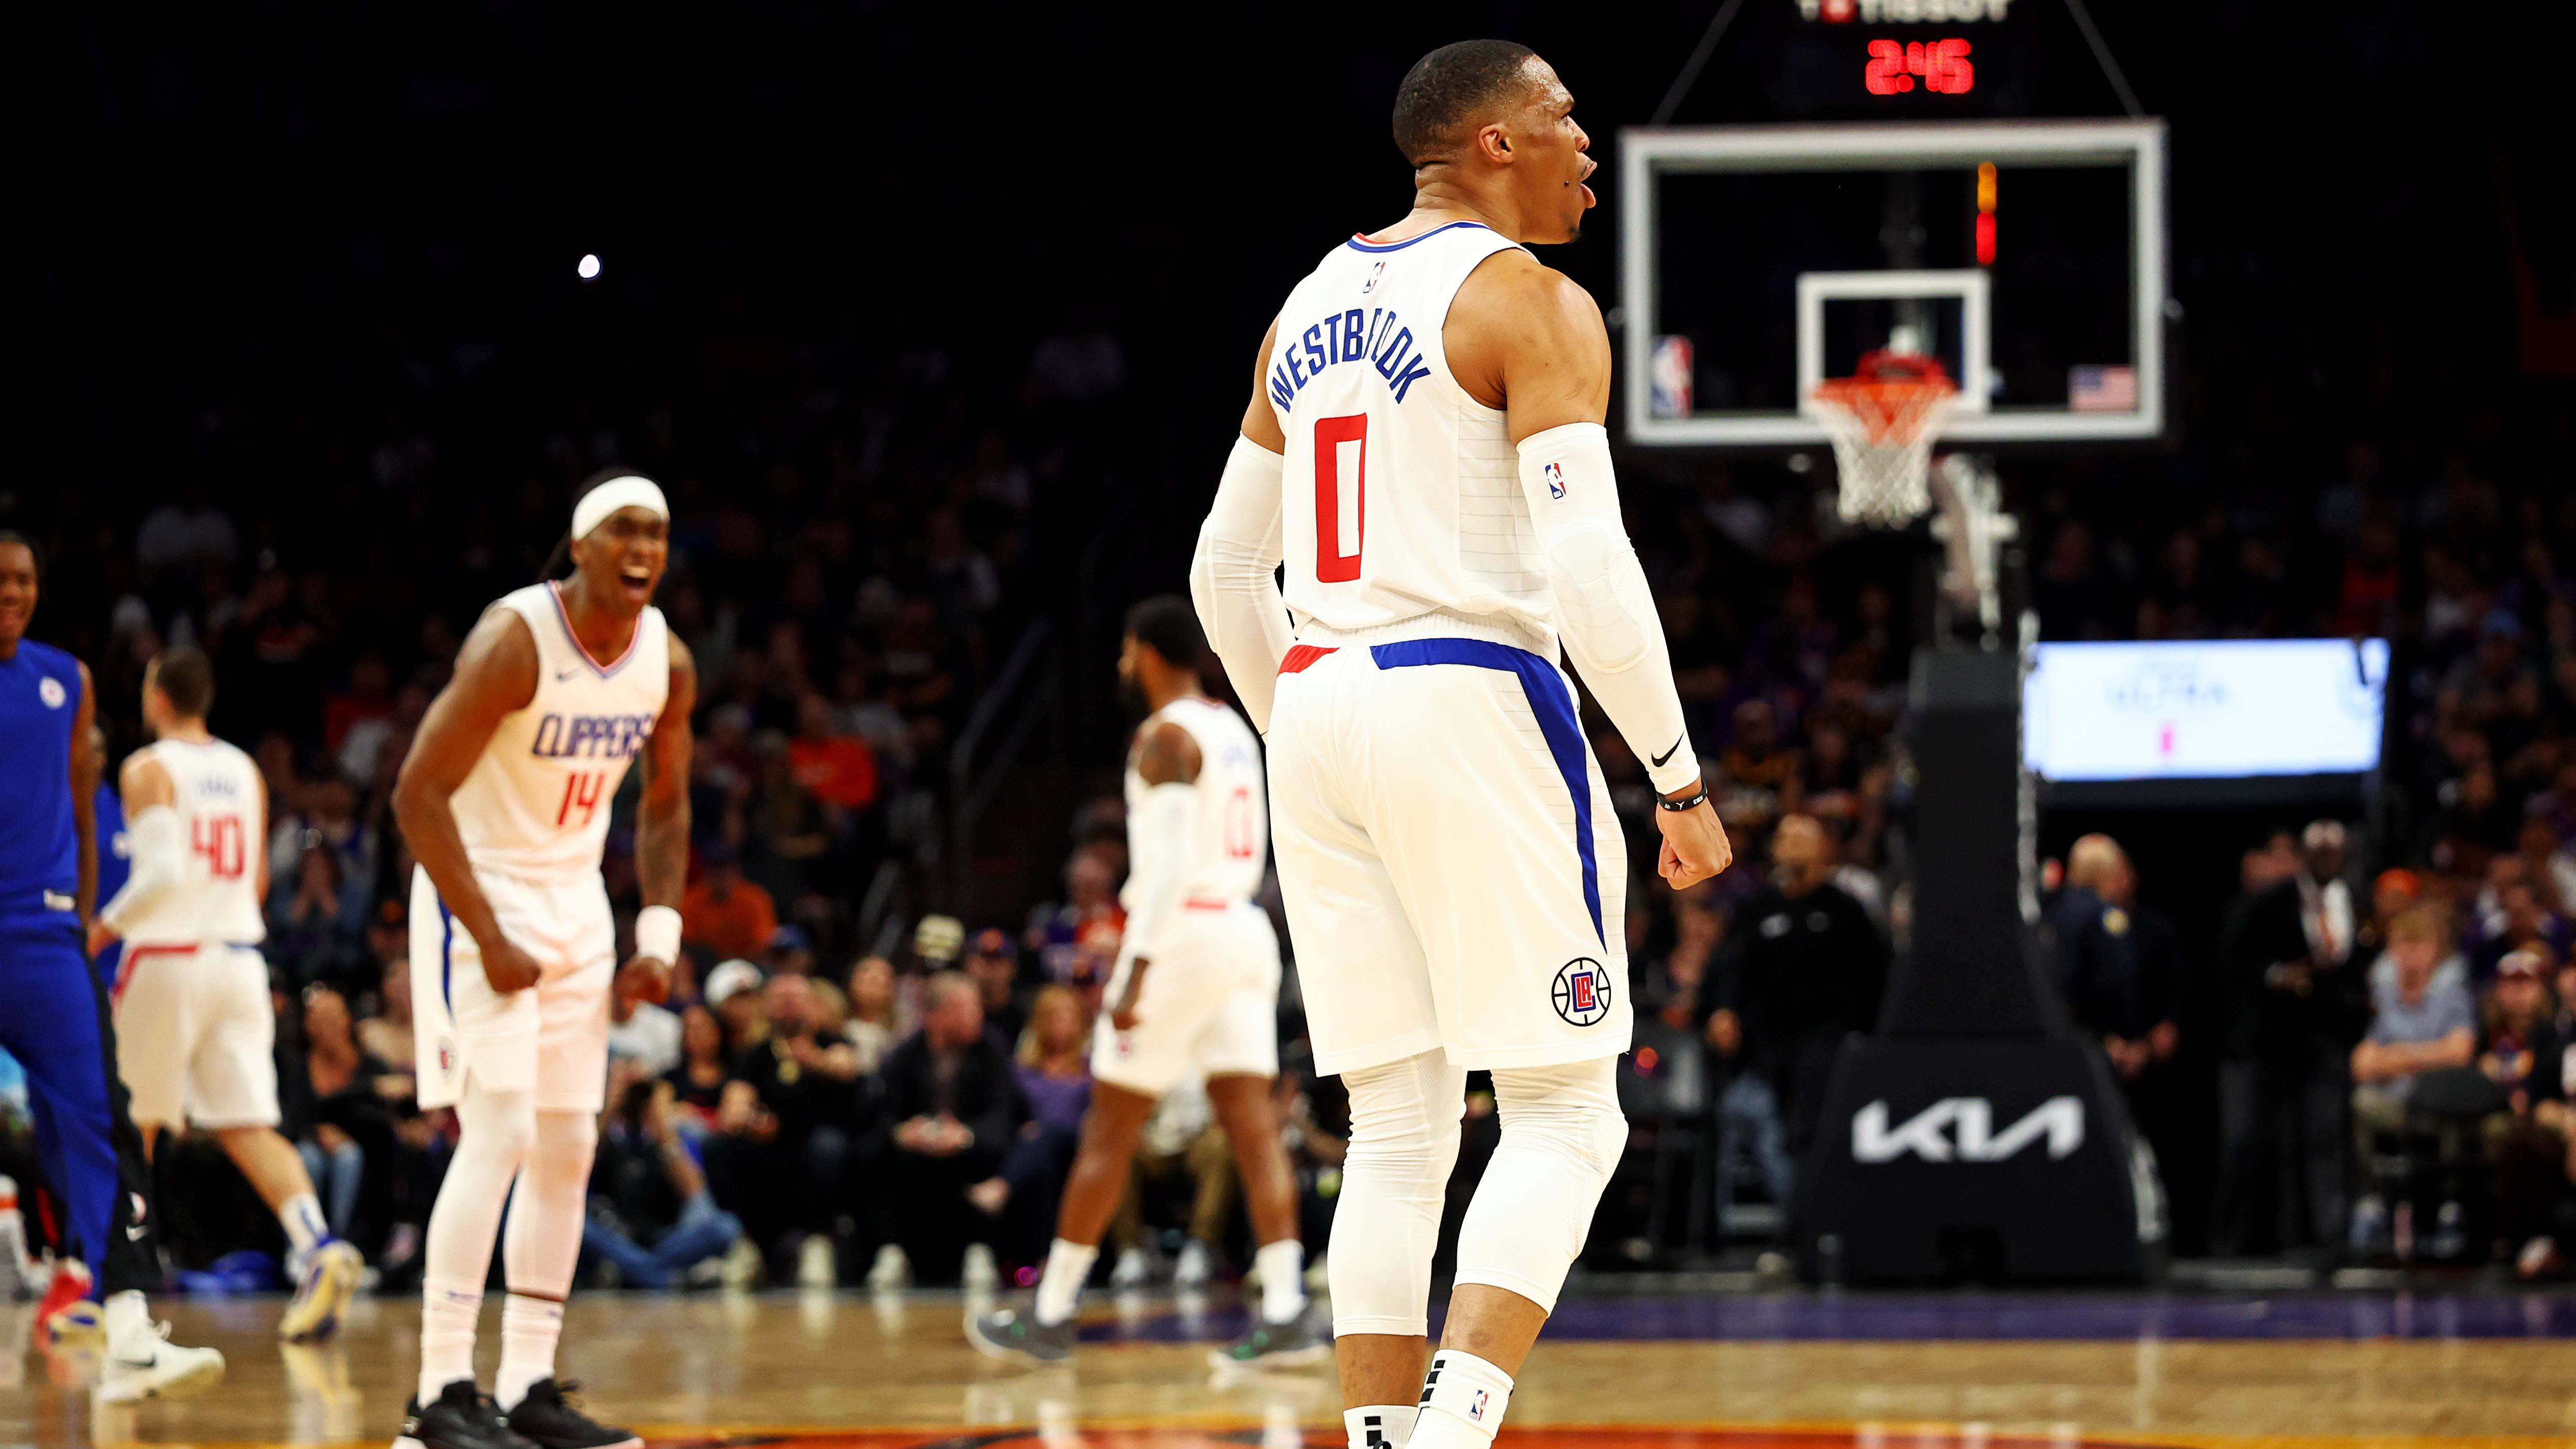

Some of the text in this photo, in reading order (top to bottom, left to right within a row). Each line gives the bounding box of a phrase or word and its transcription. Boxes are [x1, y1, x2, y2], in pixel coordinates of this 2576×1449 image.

[1865, 38, 1973, 95] 2:45
[1314, 412, 1367, 583] 0
[557, 773, 605, 826] 14
[192, 814, 245, 879] 40
[1852, 1095, 2085, 1162] KIA
